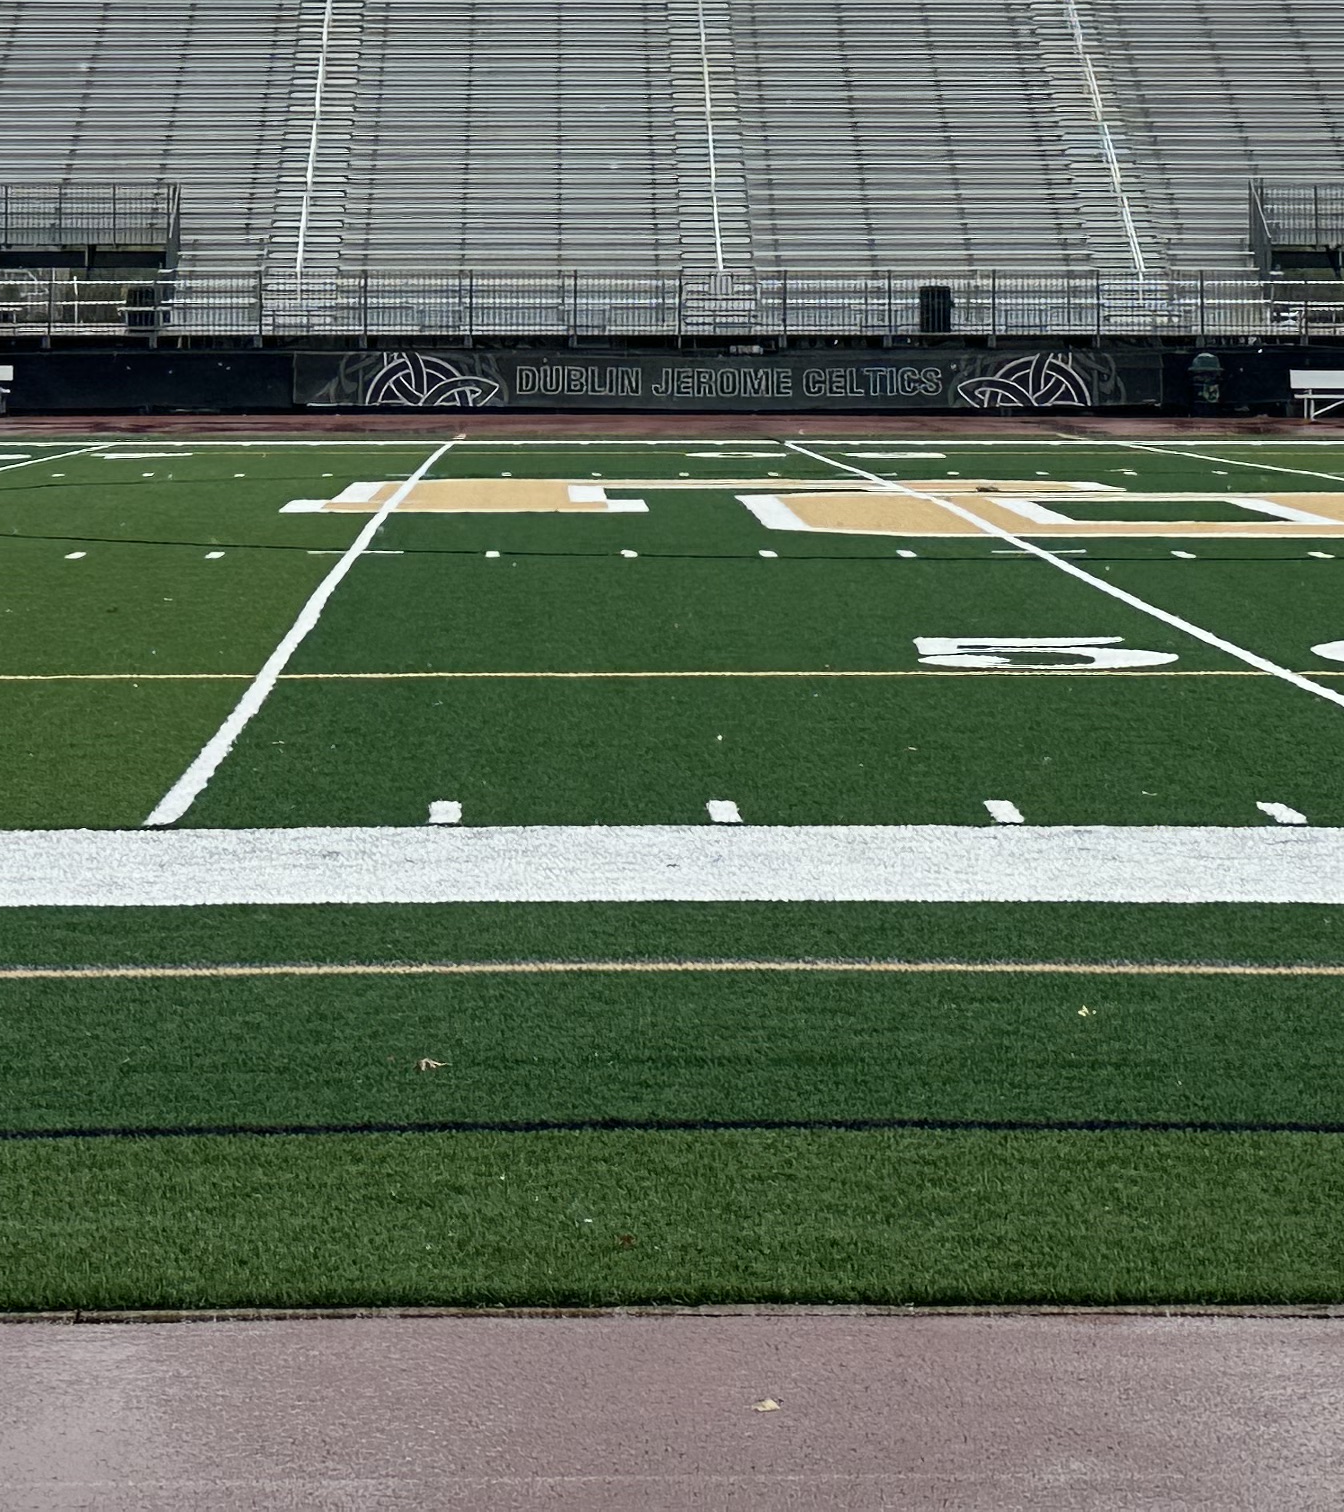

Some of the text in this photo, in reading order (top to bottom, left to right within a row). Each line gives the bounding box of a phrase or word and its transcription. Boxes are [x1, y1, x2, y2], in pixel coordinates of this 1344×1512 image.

[515, 365, 944, 397] DUBLIN JEROME CELTICS
